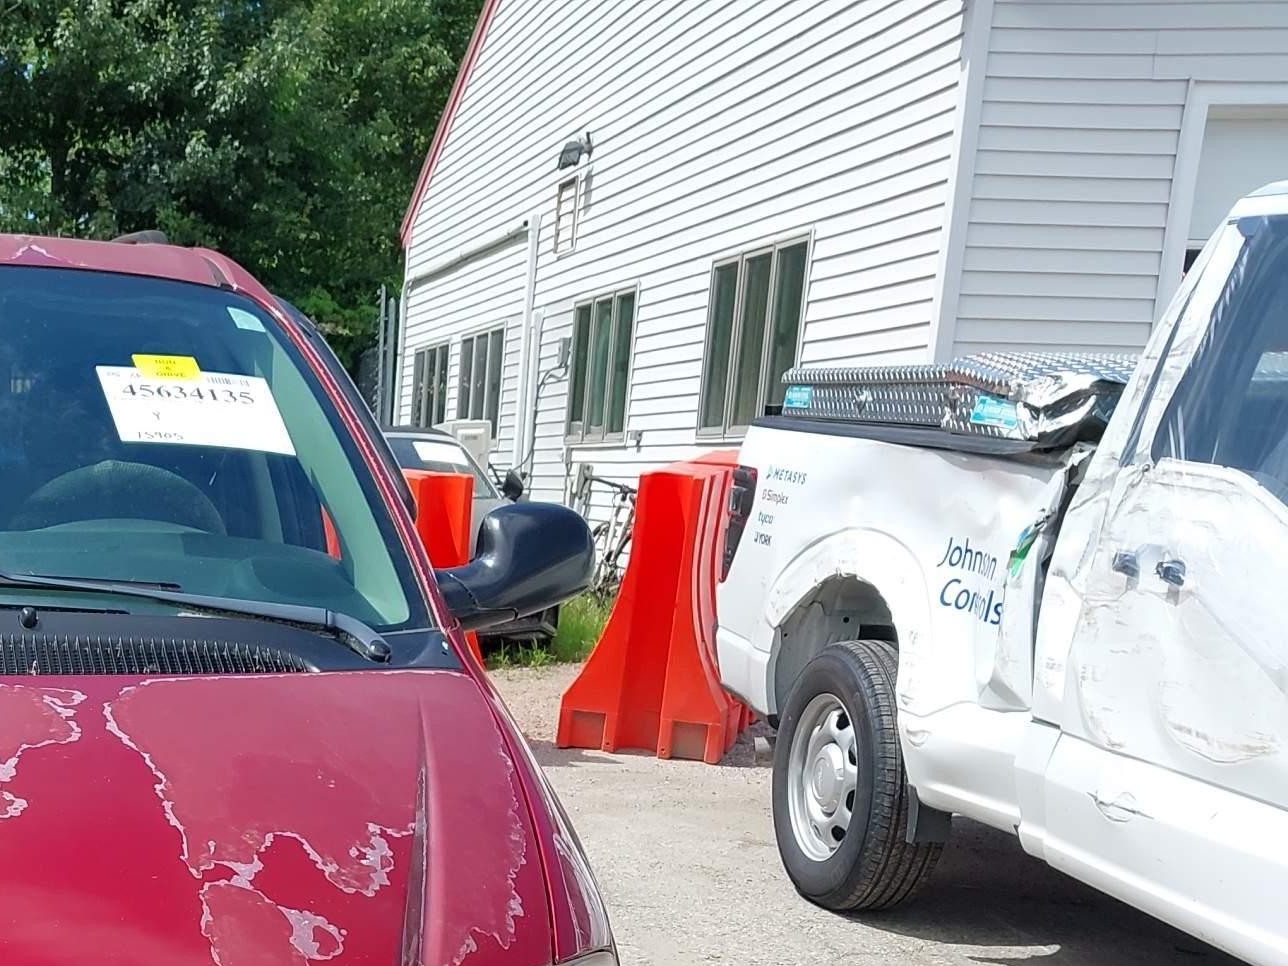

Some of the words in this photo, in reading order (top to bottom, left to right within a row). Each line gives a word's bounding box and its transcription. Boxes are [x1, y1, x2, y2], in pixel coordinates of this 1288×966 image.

[121, 384, 256, 405] 45634135
[773, 467, 807, 485] METASYS
[767, 489, 789, 506] Simplex
[758, 511, 774, 526] tyco
